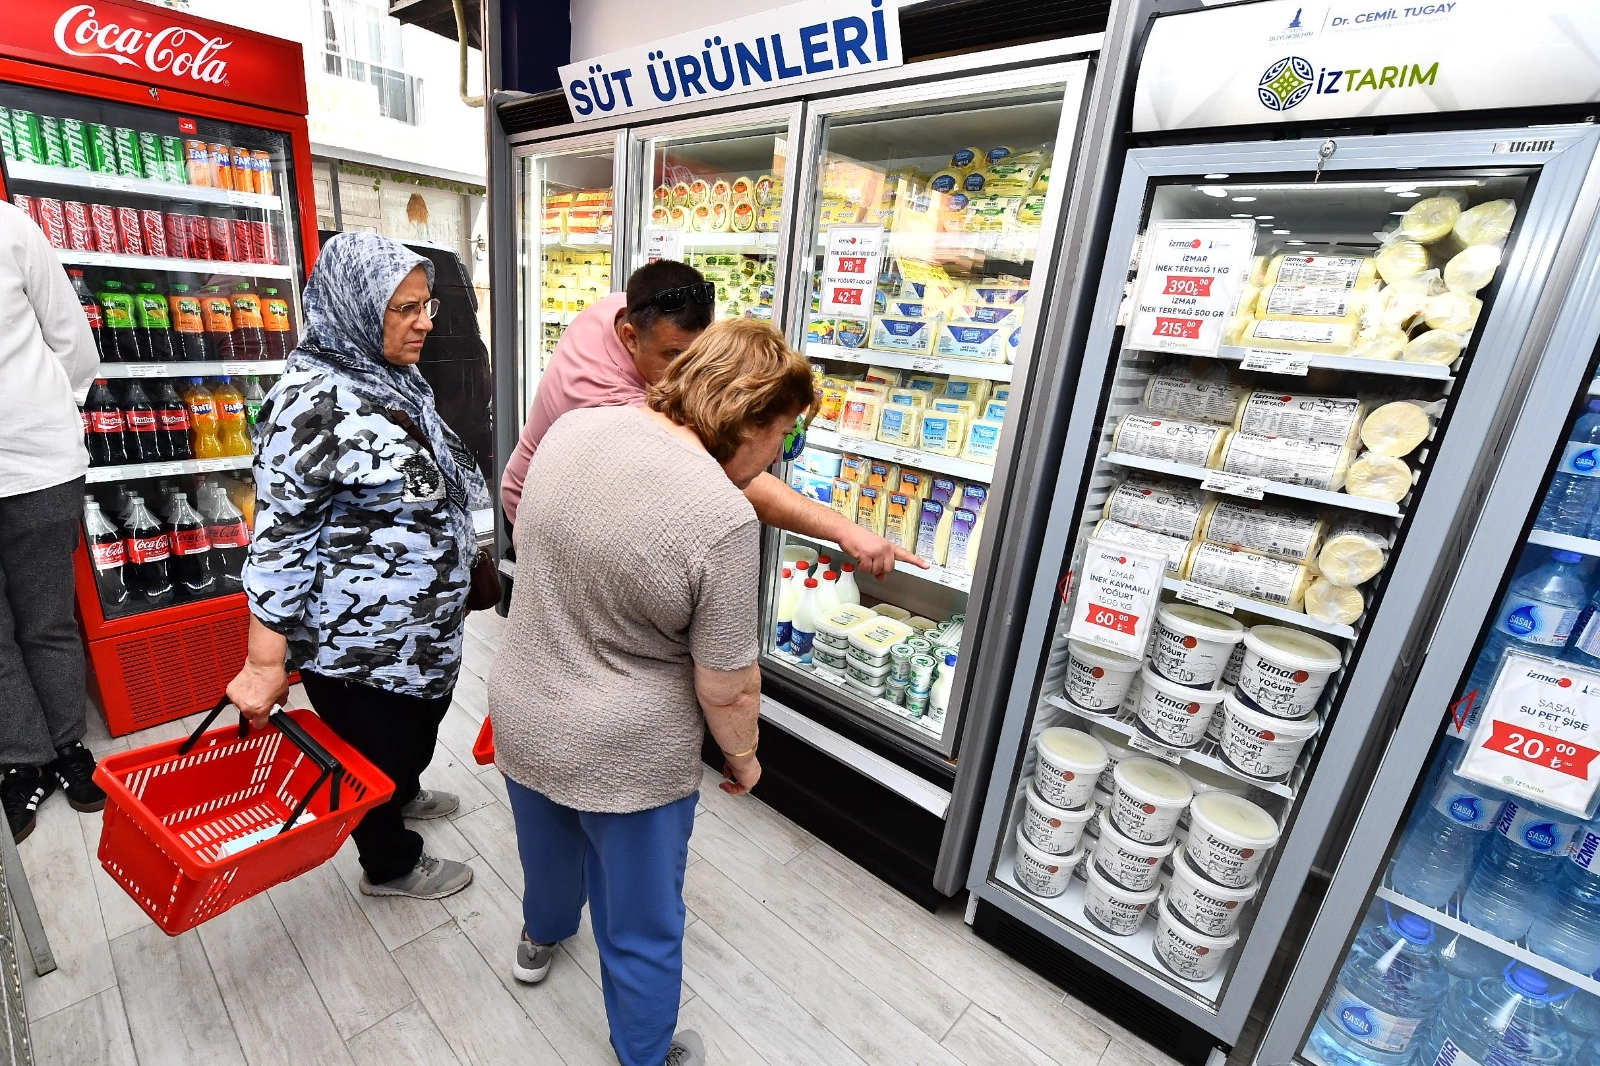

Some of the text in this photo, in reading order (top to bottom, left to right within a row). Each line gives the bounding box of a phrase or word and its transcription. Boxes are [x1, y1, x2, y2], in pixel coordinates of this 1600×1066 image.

[1331, 17, 1349, 27] Dr.
[1355, 8, 1398, 23] CEMİL
[1404, 2, 1456, 17] TUGAY
[54, 5, 233, 84] Coca-Cola
[569, 0, 889, 116] SÜT ÜRÜNLERİ
[1316, 61, 1439, 95] İZTARIM
[1155, 264, 1173, 272] İNEK
[1175, 264, 1211, 273] TEREYAĞ
[1140, 304, 1156, 313] İNEK
[1159, 306, 1193, 316] TEREYAĞ
[1171, 297, 1197, 305] İZMAR
[1089, 573, 1151, 595] İNEK KAYMAKLI
[1101, 587, 1134, 600] YOĞURT
[1099, 595, 1132, 611] 1500 KG
[1160, 642, 1187, 659] YOĞURT
[1257, 657, 1299, 679] izmar
[1527, 670, 1560, 684] izmar
[1071, 670, 1096, 687] YOĞURT
[1260, 677, 1297, 694] YOĞURT
[1155, 691, 1190, 711] izmar
[1538, 699, 1577, 717] ŞAŞAL
[1157, 709, 1190, 724] YOĞURT
[1519, 705, 1589, 732] SU PET ŞİŞE
[1231, 714, 1264, 738] izmar
[1230, 732, 1264, 753] YOĞURT
[1041, 772, 1067, 790] YOĞURT
[1119, 803, 1147, 822] YOĞURT
[1452, 802, 1475, 819] SASAL
[1206, 834, 1244, 855] izmar
[1527, 830, 1552, 845] SASAL
[1120, 862, 1150, 874] YOĞURT
[1209, 850, 1244, 868] YOĞURT
[1025, 866, 1051, 881] YOĞURT
[1111, 909, 1139, 919] YOĞURT
[1196, 904, 1228, 919] YOĞURT
[1169, 941, 1198, 962] YOĞURT
[1343, 1010, 1369, 1033] SASAL
